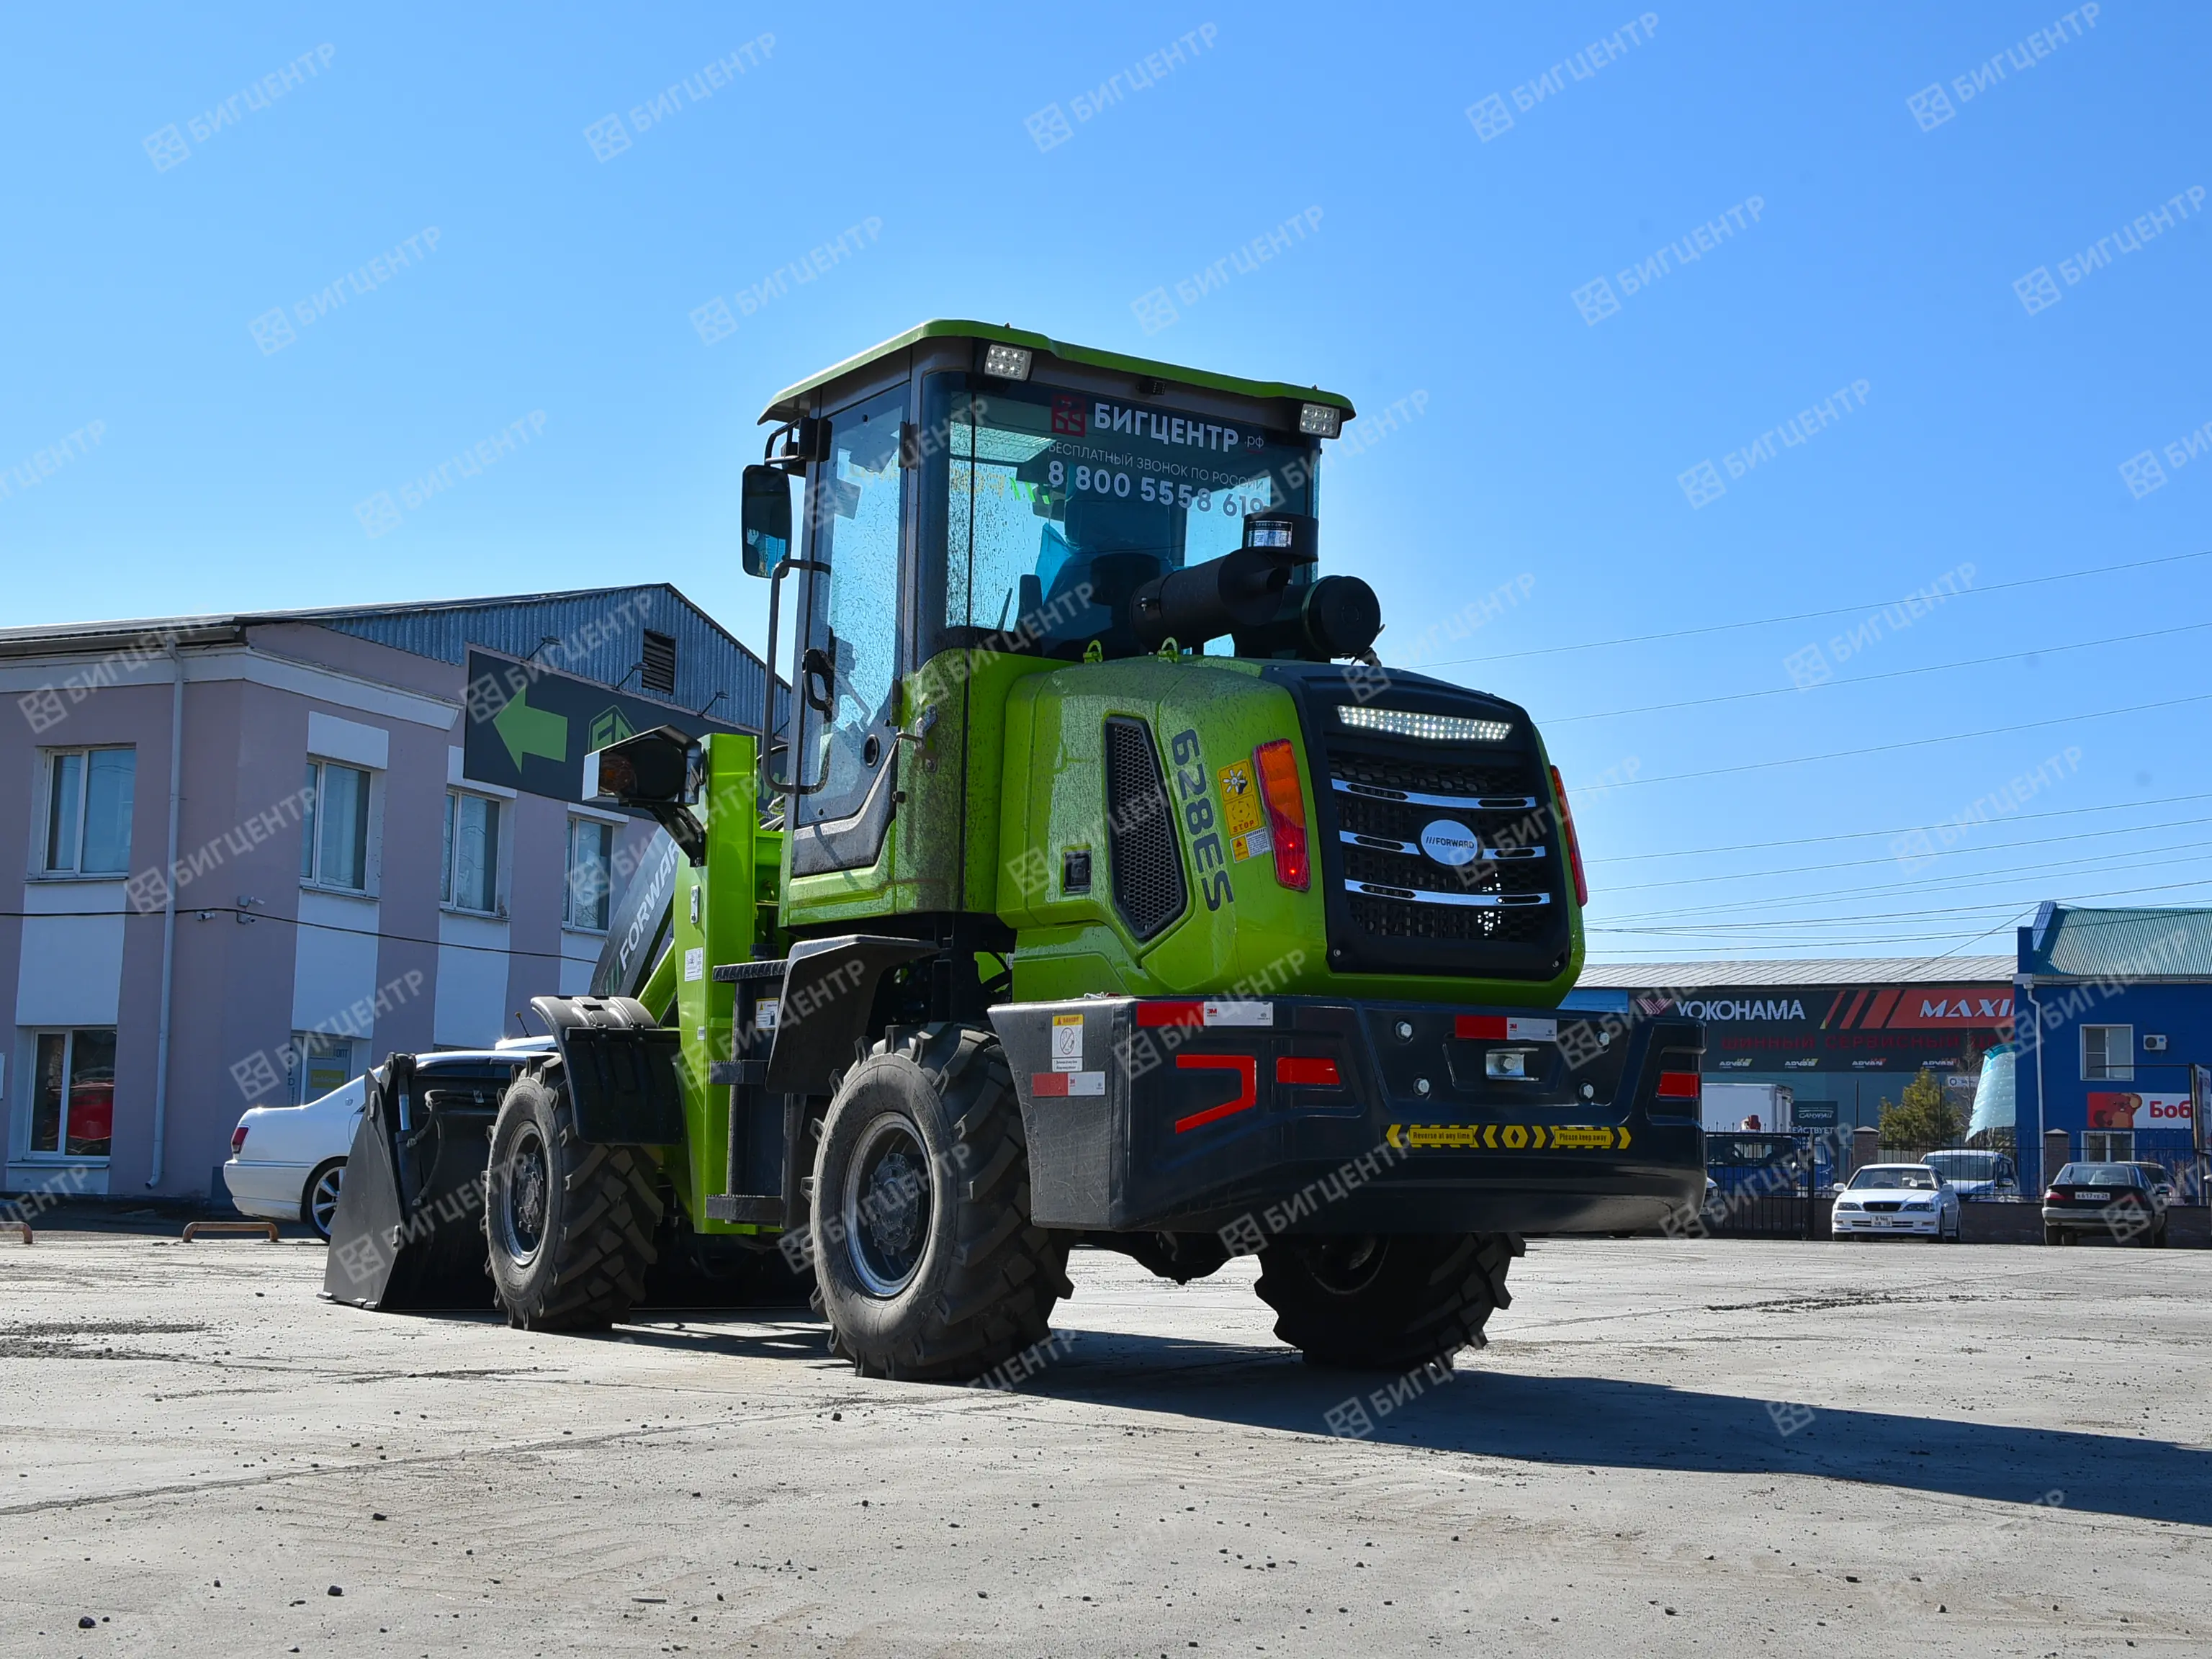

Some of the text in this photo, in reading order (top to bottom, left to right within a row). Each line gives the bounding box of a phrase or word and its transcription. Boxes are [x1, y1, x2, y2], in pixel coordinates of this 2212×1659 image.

[1094, 403, 1238, 452] БИГЦЕНТР
[1048, 442, 1263, 490] БЕСПЛАТНЫЙ ЗВОНОК ПО РОССИИ
[1048, 460, 1064, 485] 8
[1075, 465, 1130, 498] 800
[1141, 477, 1211, 512] 5558
[1171, 729, 1234, 912] 628ES
[1233, 819, 1254, 833] STOP
[619, 837, 680, 971] FORWAR
[1676, 999, 1806, 1020] YOKOHAMA
[1919, 999, 2014, 1017] MAXI
[1722, 1033, 1815, 1050] ШИННЫЙ
[1825, 1033, 1959, 1050] СЕРВИСНЫЙ
[1579, 1133, 1591, 1142] keep
[1791, 1125, 1834, 1134] ЕЙСТВУЕТ
